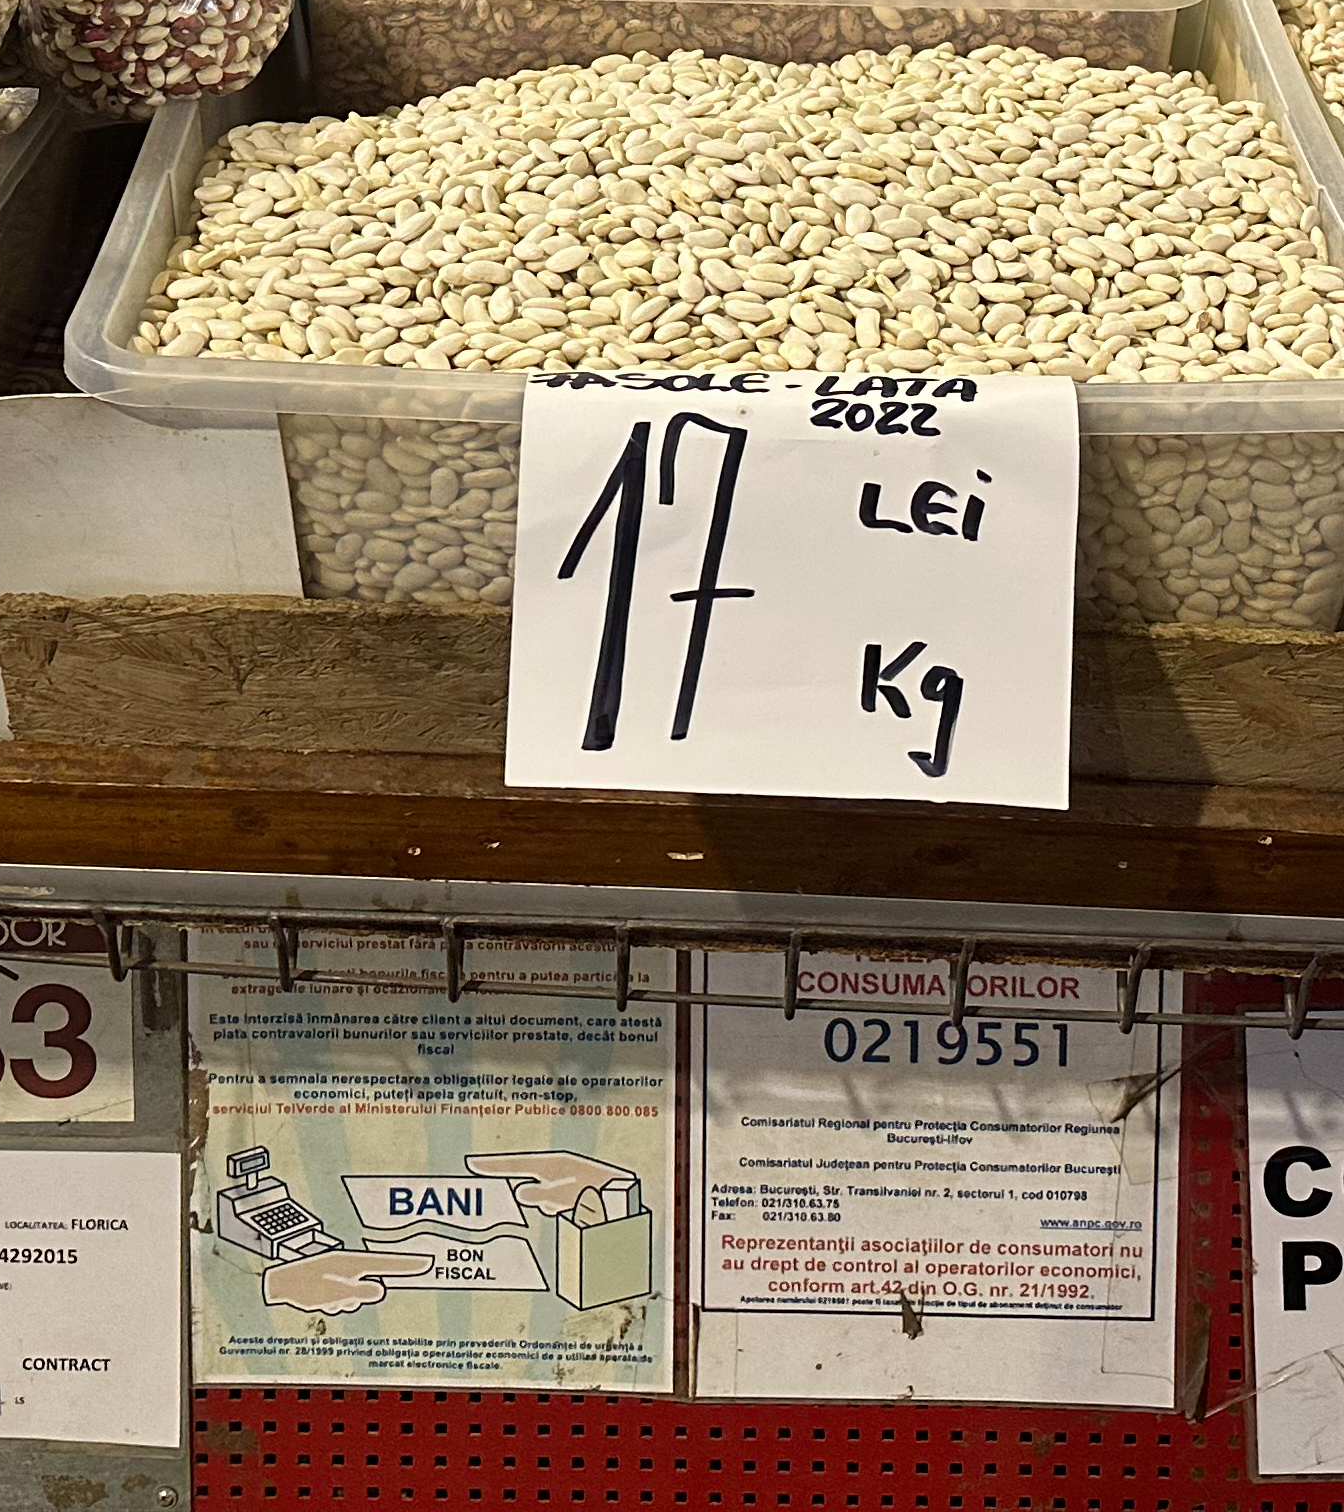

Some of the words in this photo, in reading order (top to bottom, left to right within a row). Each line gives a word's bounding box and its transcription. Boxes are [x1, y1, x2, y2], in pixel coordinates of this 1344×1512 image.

[811, 400, 941, 437] 2022
[557, 411, 756, 751] 17
[860, 641, 964, 778] Kg
[796, 971, 1080, 999] CONSUMAORILOR
[209, 1013, 240, 1025] Este
[307, 1014, 379, 1025] înmânarea
[383, 1014, 418, 1025] către
[422, 1015, 460, 1026] client
[475, 1016, 506, 1026] altui
[509, 1016, 582, 1028] document,
[586, 1018, 616, 1028] care
[213, 1029, 247, 1041] plata
[252, 1029, 339, 1040] contravalorii
[343, 1029, 407, 1040] bunurilor
[411, 1030, 435, 1040] sau
[439, 1031, 509, 1041] serviciilor
[513, 1031, 573, 1043] prestate,
[576, 1031, 615, 1042] decât
[618, 1031, 658, 1043] bonul
[824, 1017, 1068, 1067] 0219551
[418, 1044, 454, 1055] fiscal
[208, 1073, 254, 1085] Pentru
[258, 1076, 266, 1084] a
[269, 1074, 327, 1085] semnala
[331, 1074, 430, 1087] nerespectarea
[512, 1076, 554, 1088] legale
[557, 1077, 577, 1087] ale
[581, 1077, 663, 1088] operatorilor
[293, 1089, 370, 1100] economici,
[417, 1090, 454, 1102] apela
[212, 1103, 272, 1115] serviciul
[276, 1103, 335, 1114] TelVerde
[339, 1104, 351, 1114] al
[355, 1103, 437, 1115] Ministerului
[514, 1105, 566, 1116] Publice
[569, 1105, 602, 1116] 0800
[606, 1105, 630, 1116] 800
[634, 1106, 659, 1117] 085
[741, 1116, 815, 1128] Comisariatul
[818, 1118, 870, 1131] Regional
[873, 1119, 911, 1131] pentru
[970, 1121, 1062, 1133] Consumatorilor
[1064, 1123, 1120, 1136] Regiunea
[739, 1157, 813, 1169] Comisariatul
[873, 1159, 911, 1172] pentru
[970, 1162, 1062, 1173] Consumatorilor
[711, 1183, 757, 1195] Adresa:
[822, 1185, 843, 1196] Str.
[847, 1186, 921, 1197] Transilvaniei
[924, 1189, 941, 1198] nr.
[943, 1188, 953, 1200] 2,
[957, 1189, 1005, 1200] sectorul
[1022, 1190, 1043, 1200] cod
[1046, 1190, 1088, 1201] 010798
[388, 1186, 484, 1217] BANI
[711, 1197, 759, 1208] Telefon:
[761, 1198, 840, 1208] 021/310.63.75
[711, 1211, 736, 1221] Fax:
[762, 1211, 841, 1222] 021/310.63.80
[71, 1218, 129, 1231] FLORICA
[1040, 1218, 1143, 1231] www.anpc.gov.ro
[446, 1248, 484, 1263] BON
[969, 1240, 991, 1254] de
[997, 1242, 1113, 1258] consumatori
[1120, 1245, 1143, 1258] nu
[435, 1266, 496, 1280] FISCAL
[721, 1259, 744, 1271] au
[751, 1257, 799, 1274] drept
[804, 1258, 826, 1272] de
[832, 1259, 898, 1273] control
[903, 1259, 919, 1273] al
[925, 1260, 1034, 1277] operatorilor
[1040, 1264, 1141, 1282] economici,
[768, 1278, 844, 1293] conform
[850, 1280, 903, 1295] art.42
[907, 1280, 936, 1295] din
[943, 1281, 983, 1296] O.G.
[989, 1283, 1013, 1297] nr.
[1019, 1283, 1095, 1299] 21/1992.
[22, 1358, 111, 1372] CONTRACT
